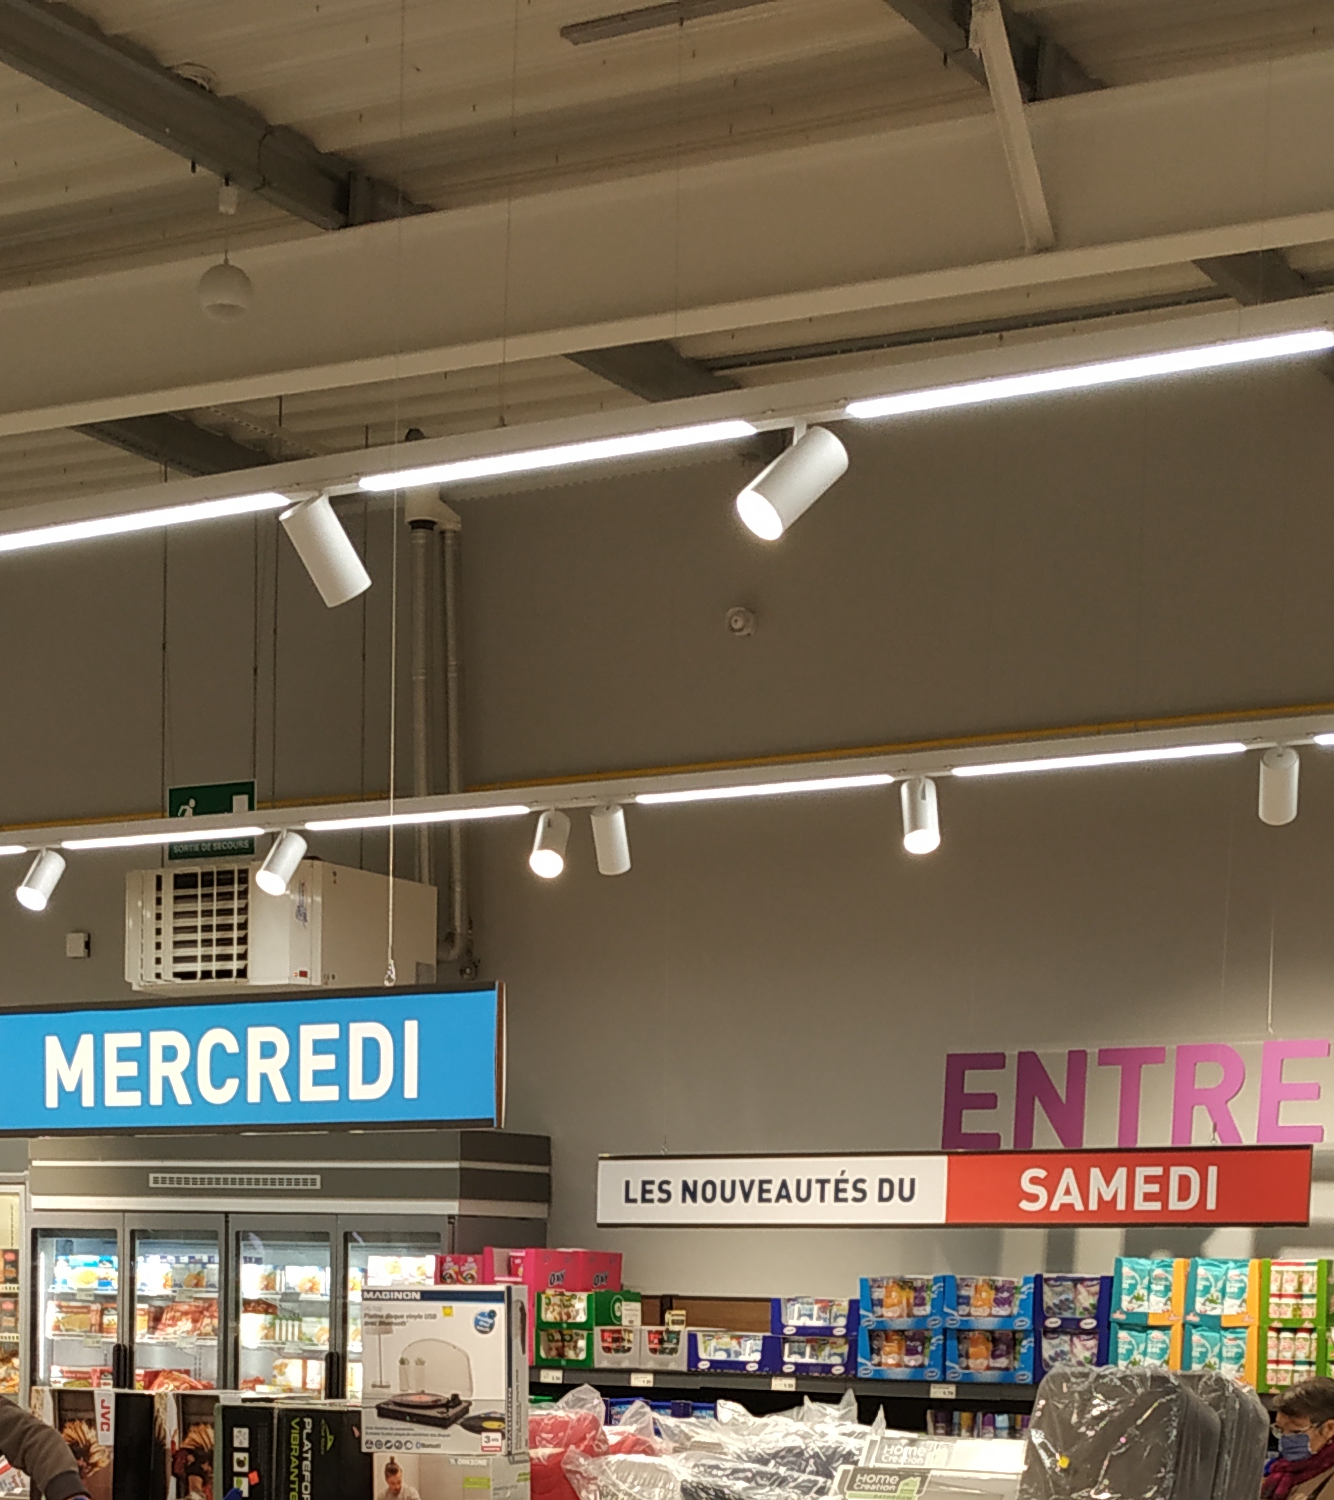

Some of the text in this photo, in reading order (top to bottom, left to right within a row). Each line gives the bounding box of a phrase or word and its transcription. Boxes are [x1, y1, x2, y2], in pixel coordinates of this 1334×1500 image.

[44, 1019, 419, 1109] MERCREDI
[623, 1169, 917, 1205] LES NOUVEAUTÉS DU
[1018, 1165, 1219, 1212] SAMEDI
[364, 1291, 421, 1300] MAGINON
[100, 1398, 111, 1433] JVC
[853, 1482, 896, 1492] Creation
[855, 1473, 899, 1485] Home
